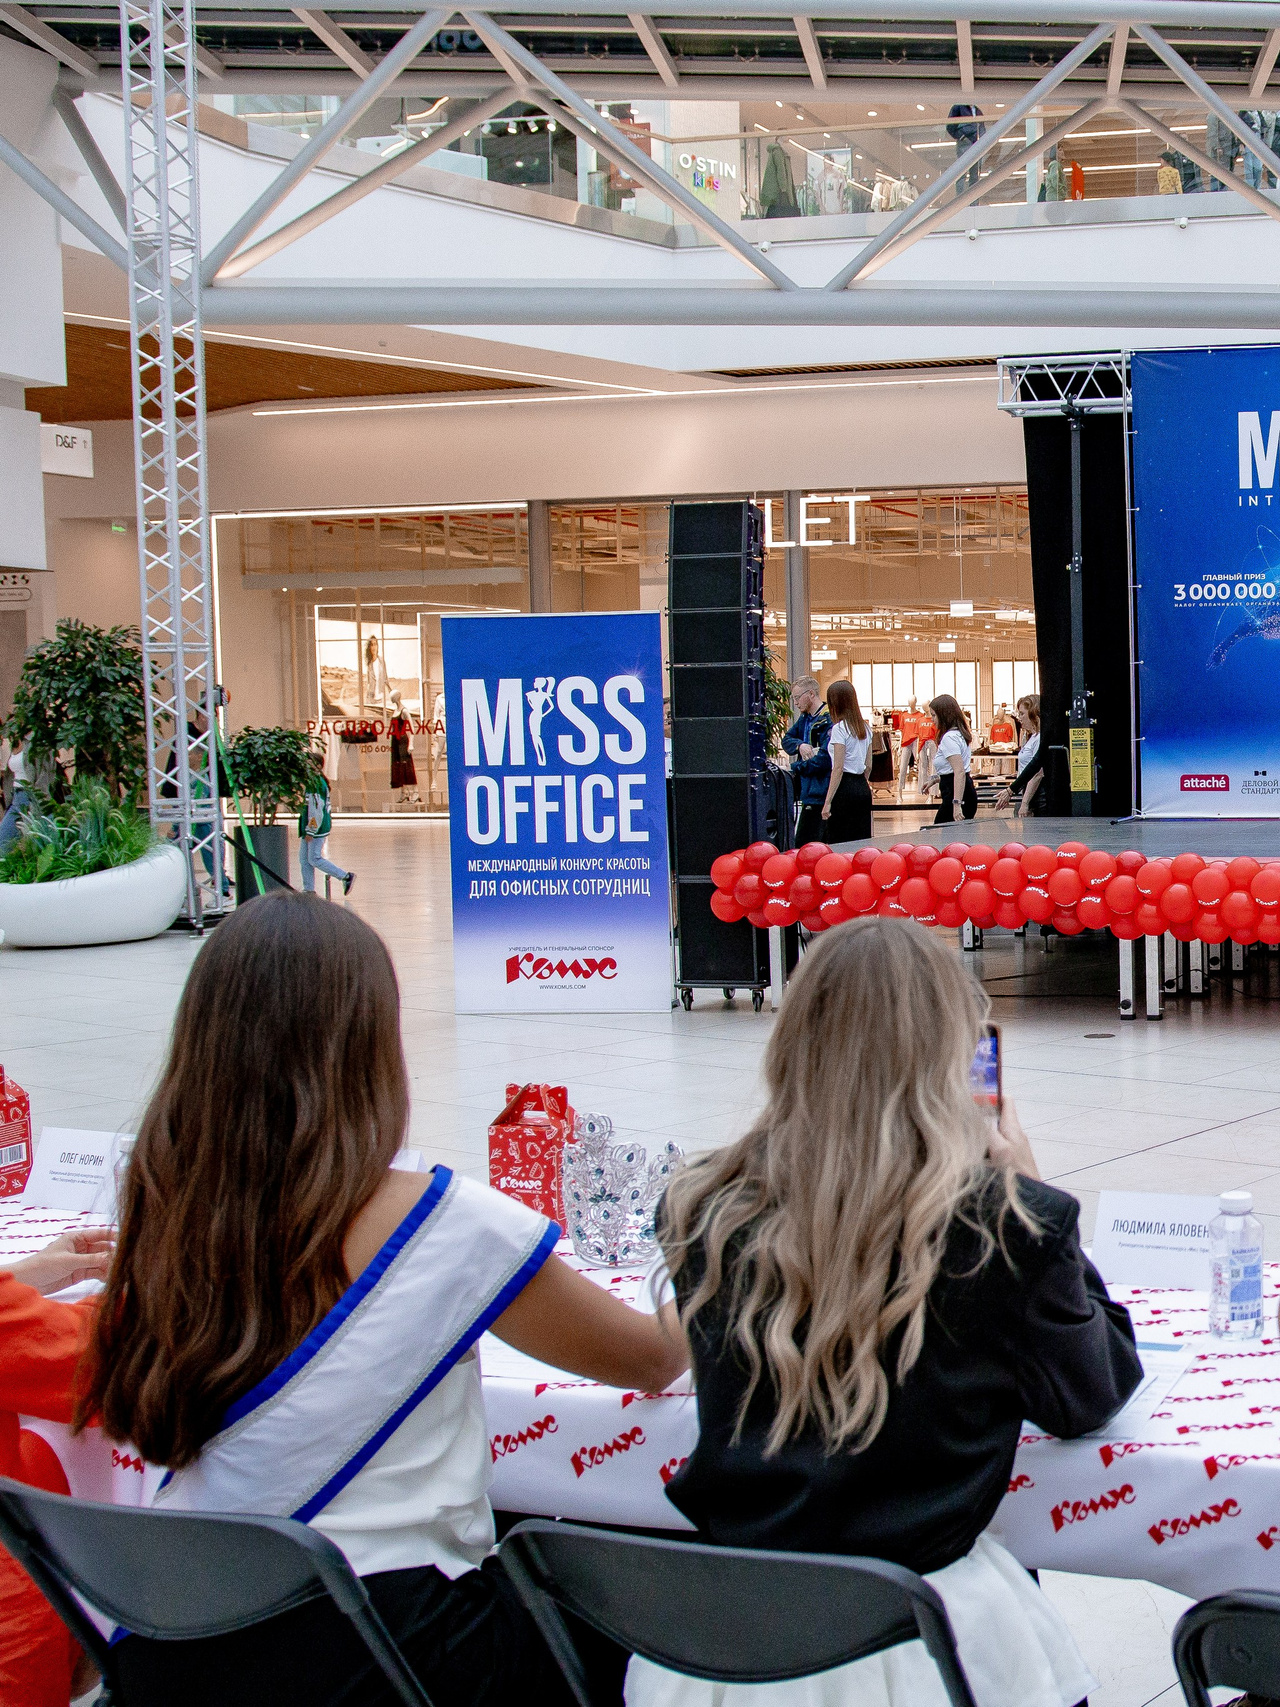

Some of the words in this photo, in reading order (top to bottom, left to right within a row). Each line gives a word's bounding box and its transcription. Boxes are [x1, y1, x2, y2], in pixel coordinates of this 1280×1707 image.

[679, 152, 737, 179] O'STIN
[693, 171, 721, 191] kids
[55, 433, 77, 449] D&F
[1202, 572, 1242, 581] ГЛАВНЫЙ
[461, 674, 647, 766] MISS
[306, 719, 446, 740] РАСПРОДАЖА
[1183, 776, 1227, 788] attaché
[1242, 779, 1279, 788] ДЕЛОВОЙ
[465, 773, 649, 845] OFFICE
[468, 857, 558, 874] МЕЖДУНАРОДНЫЙ
[560, 859, 604, 871] КОНКУРС
[606, 858, 650, 871] КРАСОТЫ
[469, 880, 497, 898] ДЛЯ
[501, 878, 569, 897] ОФИСНЫХ
[572, 878, 650, 897] СОТРУДНИЦ
[506, 953, 618, 984] Комус
[60, 1152, 79, 1164] ОЛЕГ
[79, 1153, 105, 1166] НОРИН
[1111, 1219, 1166, 1236] ЛЮДМИЛА
